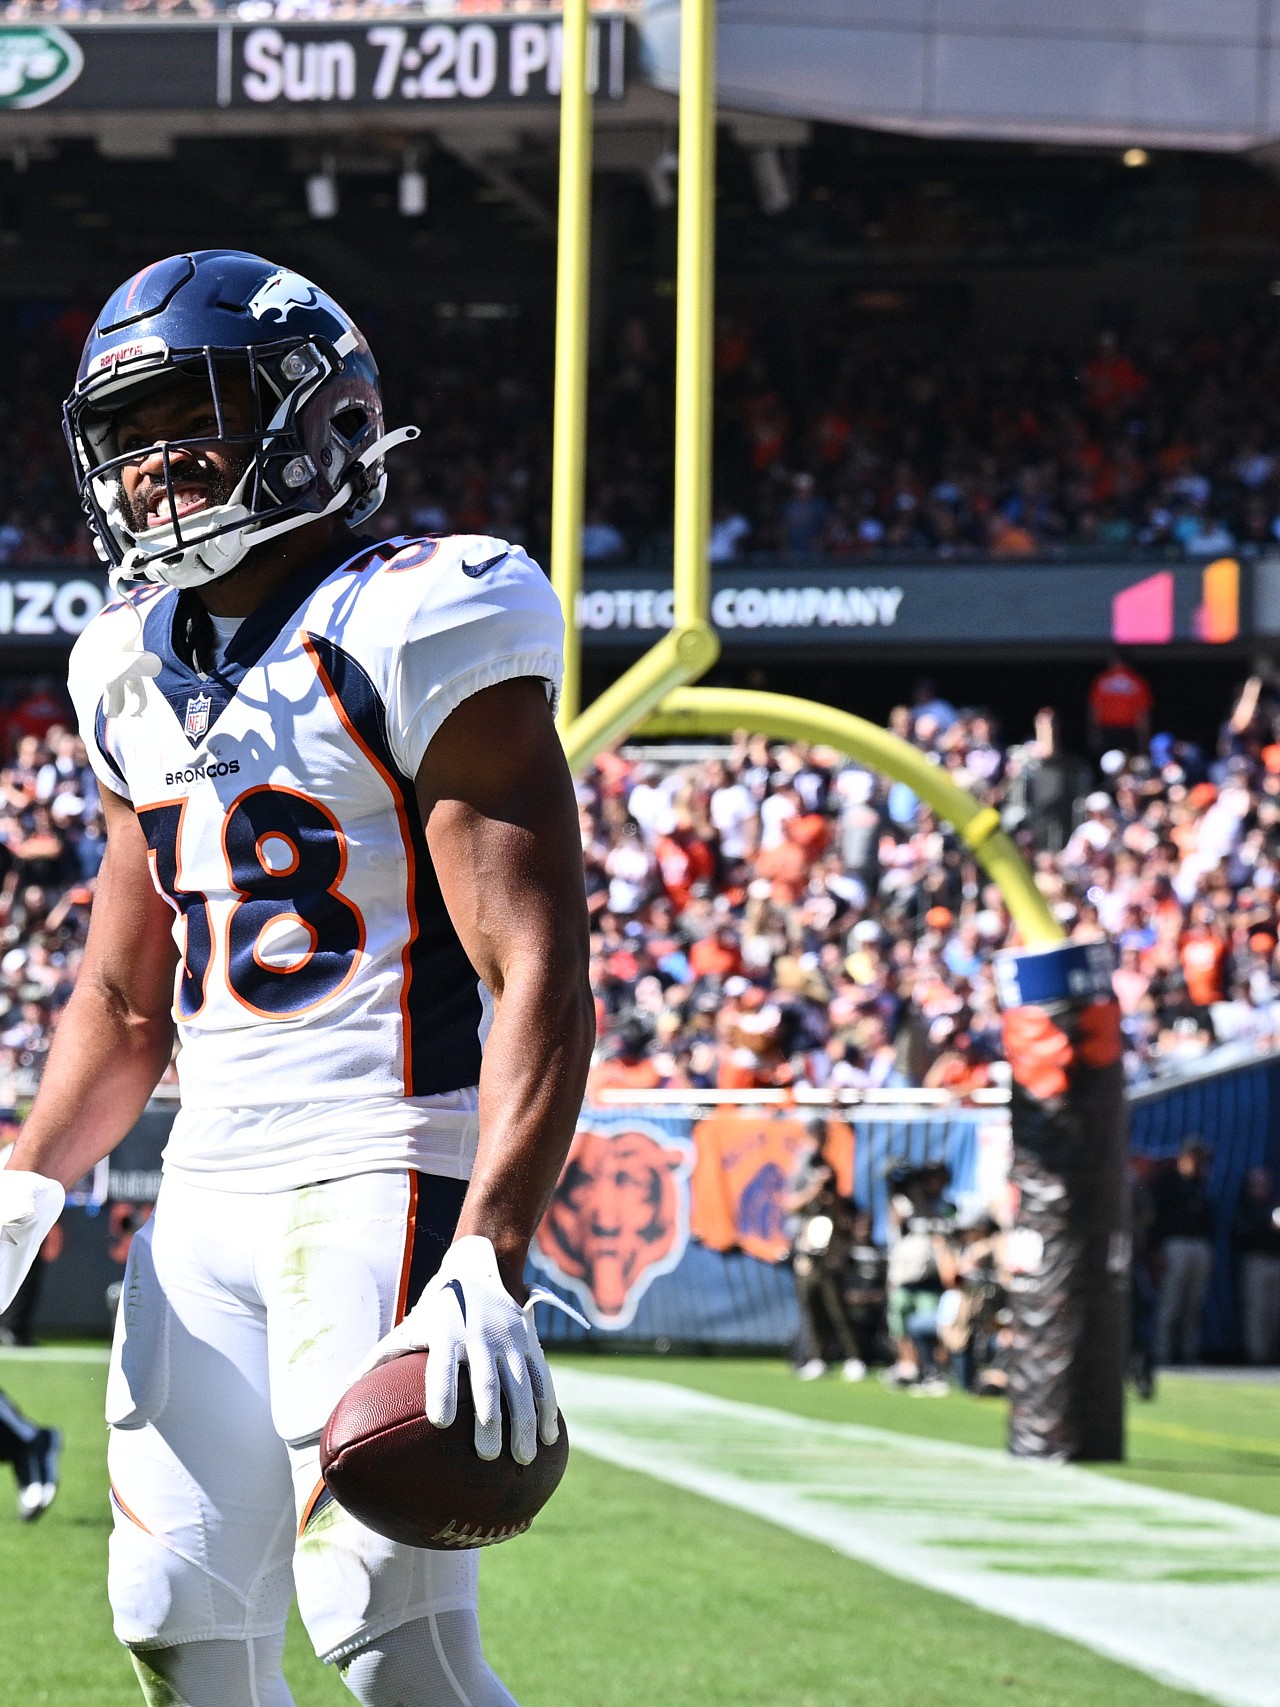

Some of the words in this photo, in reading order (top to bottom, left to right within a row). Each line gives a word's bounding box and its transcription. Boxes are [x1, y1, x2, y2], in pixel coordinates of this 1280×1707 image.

[242, 28, 356, 101] Sun
[367, 25, 497, 99] 7:20
[711, 585, 904, 629] COMPANY
[188, 714, 204, 732] NFL
[165, 759, 240, 785] BRONCOS
